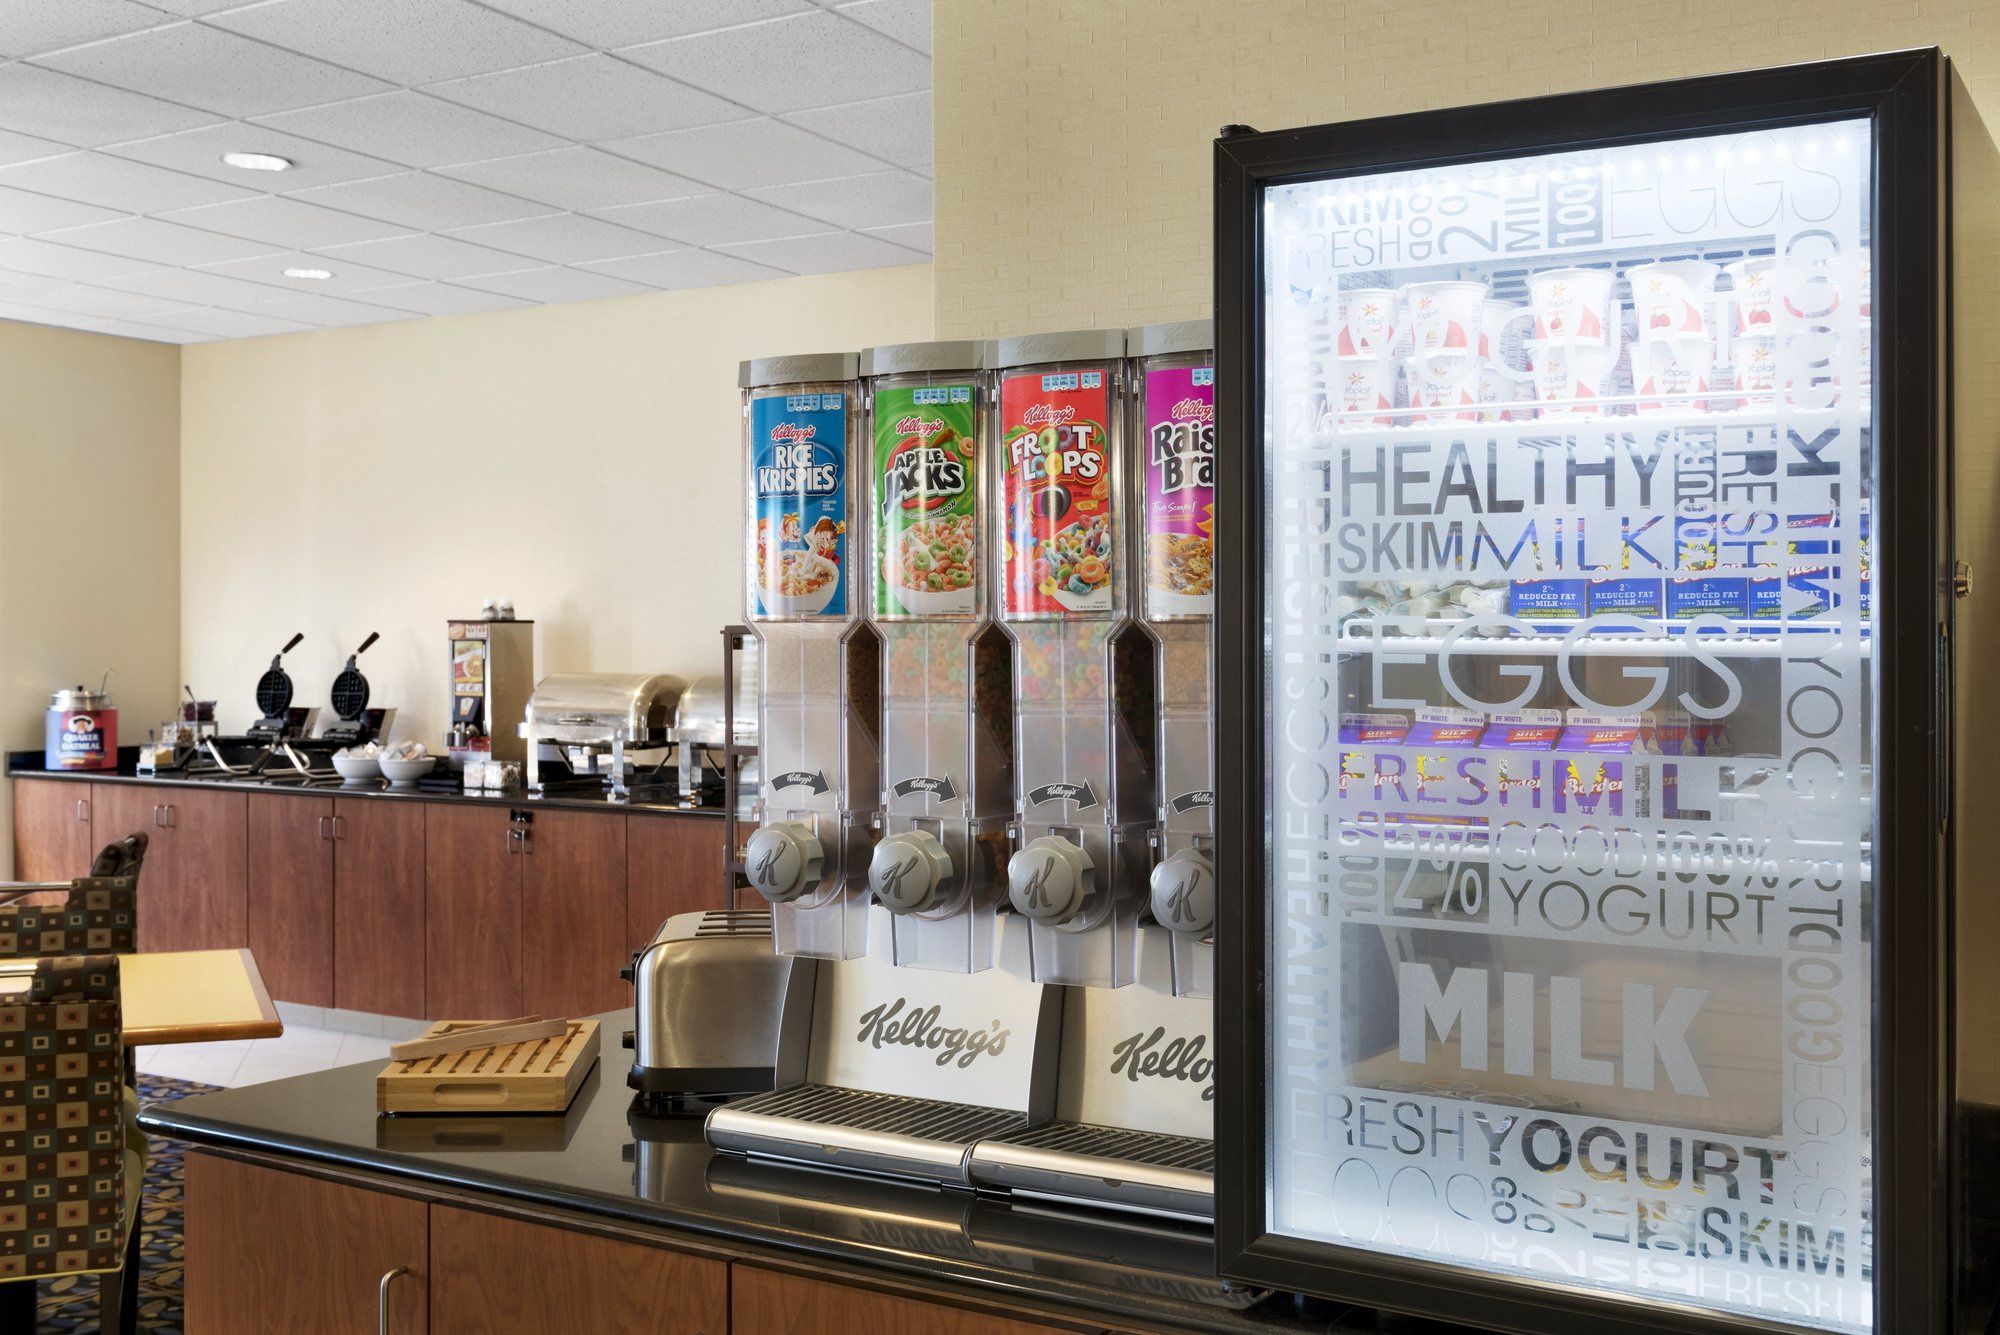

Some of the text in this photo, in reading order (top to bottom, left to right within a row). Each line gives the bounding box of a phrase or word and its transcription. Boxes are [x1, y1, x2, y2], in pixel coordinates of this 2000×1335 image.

[1611, 128, 1842, 241] EGGS
[771, 423, 816, 443] Kellogg's
[896, 416, 944, 437] Kellogg's
[1024, 404, 1076, 425] Kellogg's
[1172, 398, 1213, 422] Kellog
[774, 444, 814, 468] RICE
[894, 448, 945, 472] APPLE
[1010, 425, 1093, 467] FROOT
[1022, 449, 1101, 482] LOOPS
[759, 464, 836, 493] KRISPIES
[883, 462, 963, 520] JACKS
[1341, 430, 1664, 517] HEALTHY
[1721, 425, 1779, 568] FRESH
[1152, 501, 1197, 513] Two Scoops!
[1786, 424, 1841, 635] MILK
[1337, 515, 1669, 573] SKIM MILK
[1696, 599, 1721, 607] MILK
[1757, 591, 1781, 599] REDU
[1373, 612, 1742, 720] EGGS
[60, 742, 101, 751] OATMEAL
[62, 733, 99, 743] QUAKER
[786, 773, 814, 784] Kellogg's
[910, 778, 939, 790] Kellogg's
[1047, 785, 1077, 797] Kellogg's
[1338, 752, 1781, 823] FRESH MILK
[1498, 778, 1541, 792] orde
[1787, 655, 1843, 928] YOGURT
[755, 840, 786, 886] K
[881, 855, 918, 899] K
[1339, 811, 1379, 918] 100%
[1391, 824, 1484, 916] 2%
[1497, 820, 1781, 890] GOOD 100%
[1024, 856, 1054, 909] K
[1167, 868, 1199, 923] K
[1499, 876, 1776, 945] YOGURT
[1286, 849, 1330, 1086] HEALTHY
[1787, 924, 1843, 1063] GOOD
[857, 997, 1011, 1069] Kellogg's
[1399, 960, 1712, 1099] MILK
[1287, 1086, 1790, 1205] FRESH YOGURT
[1792, 1062, 1847, 1217] EGGS
[1701, 1207, 1846, 1279] SKIM
